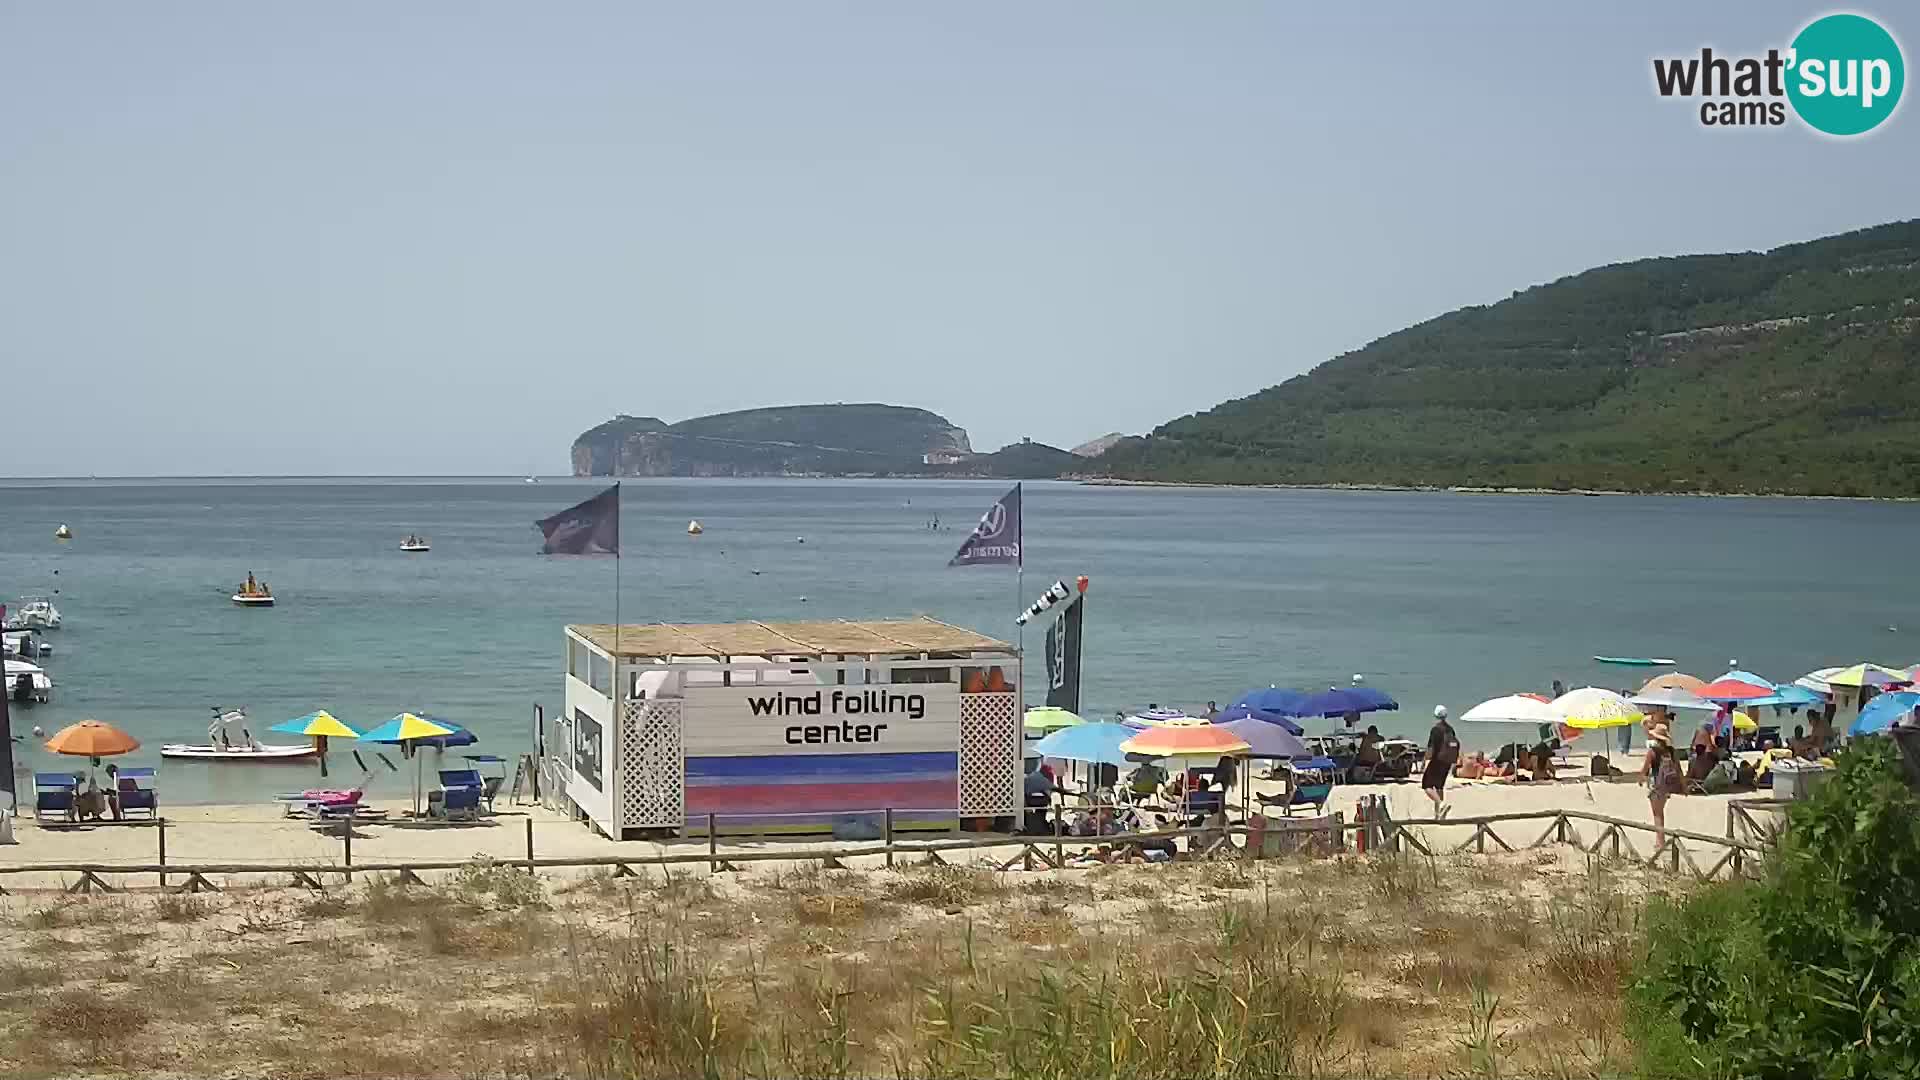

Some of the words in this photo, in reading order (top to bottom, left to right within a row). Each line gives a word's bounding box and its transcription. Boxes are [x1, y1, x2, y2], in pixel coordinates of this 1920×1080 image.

[748, 691, 821, 716] wind
[831, 690, 926, 719] foiling
[785, 720, 888, 744] center
